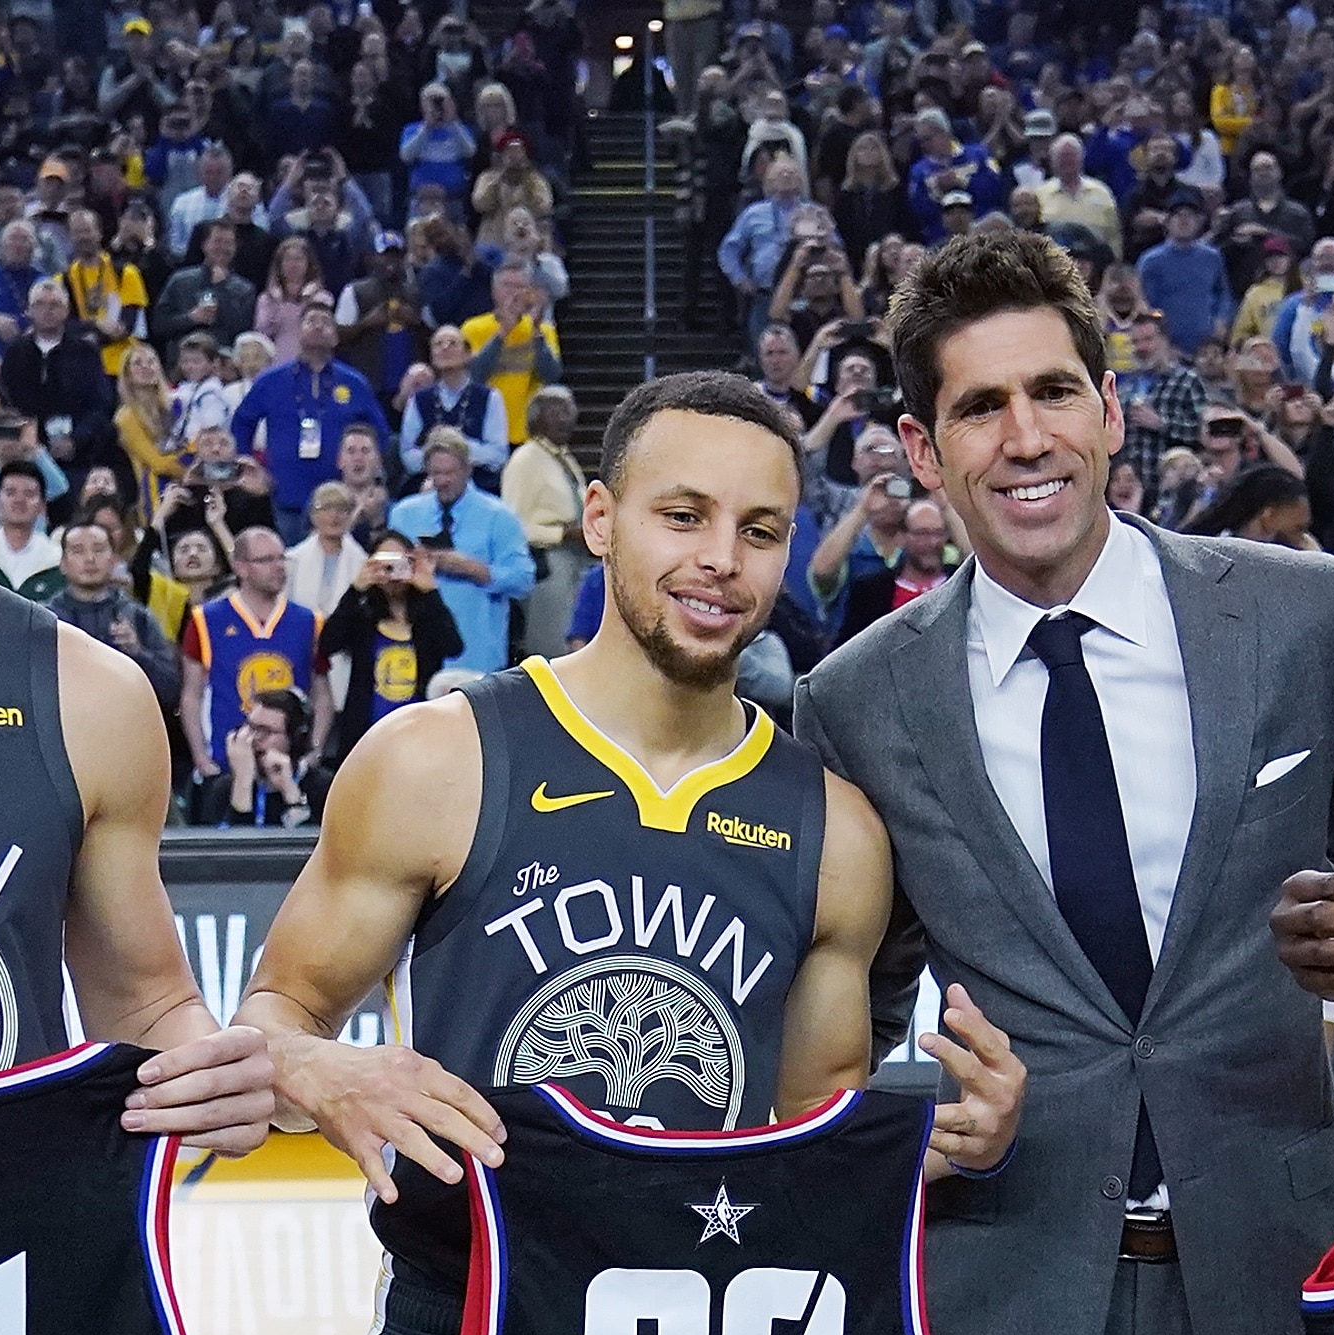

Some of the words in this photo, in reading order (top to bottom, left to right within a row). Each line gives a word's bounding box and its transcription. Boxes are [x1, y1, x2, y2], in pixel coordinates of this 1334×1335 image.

[705, 811, 792, 851] Rakuten
[512, 860, 561, 897] The
[484, 874, 774, 1007] TOWN
